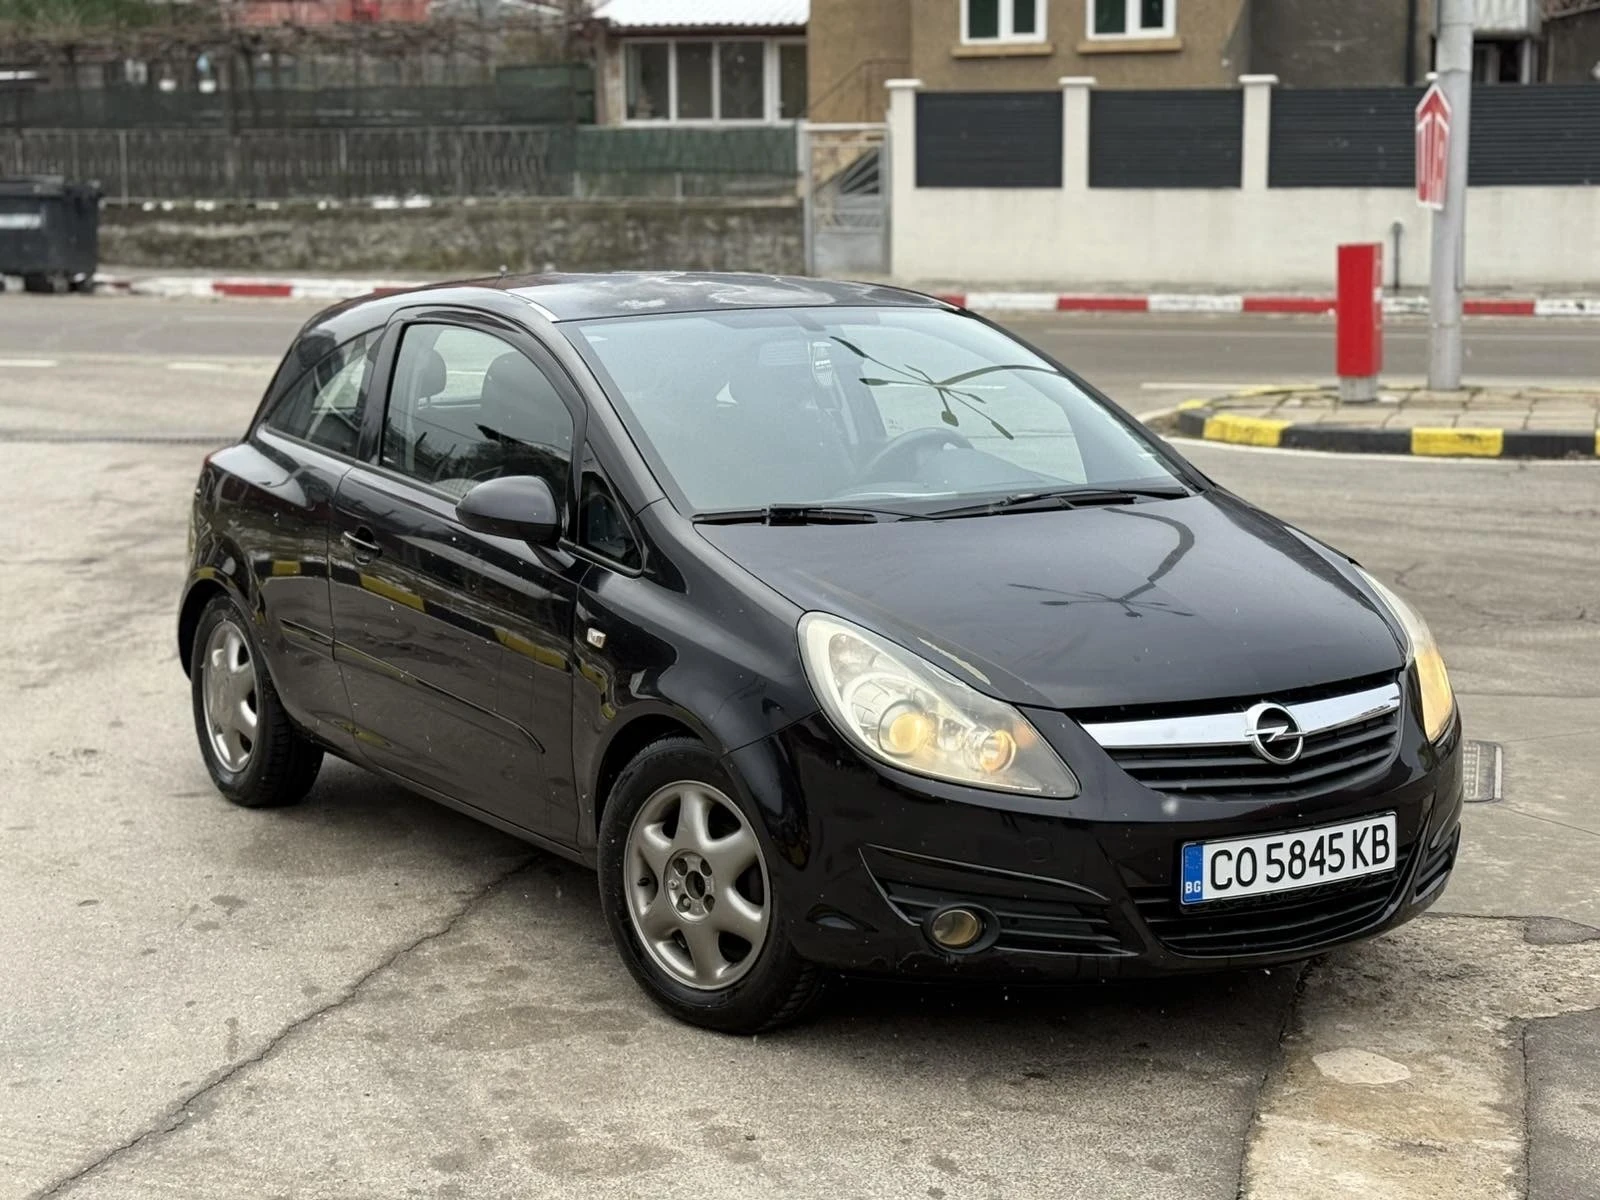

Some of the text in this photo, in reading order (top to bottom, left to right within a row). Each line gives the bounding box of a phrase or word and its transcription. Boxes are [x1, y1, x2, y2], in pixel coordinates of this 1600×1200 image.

[1210, 823, 1390, 891] CO 5845 KB
[1185, 880, 1201, 894] BG
